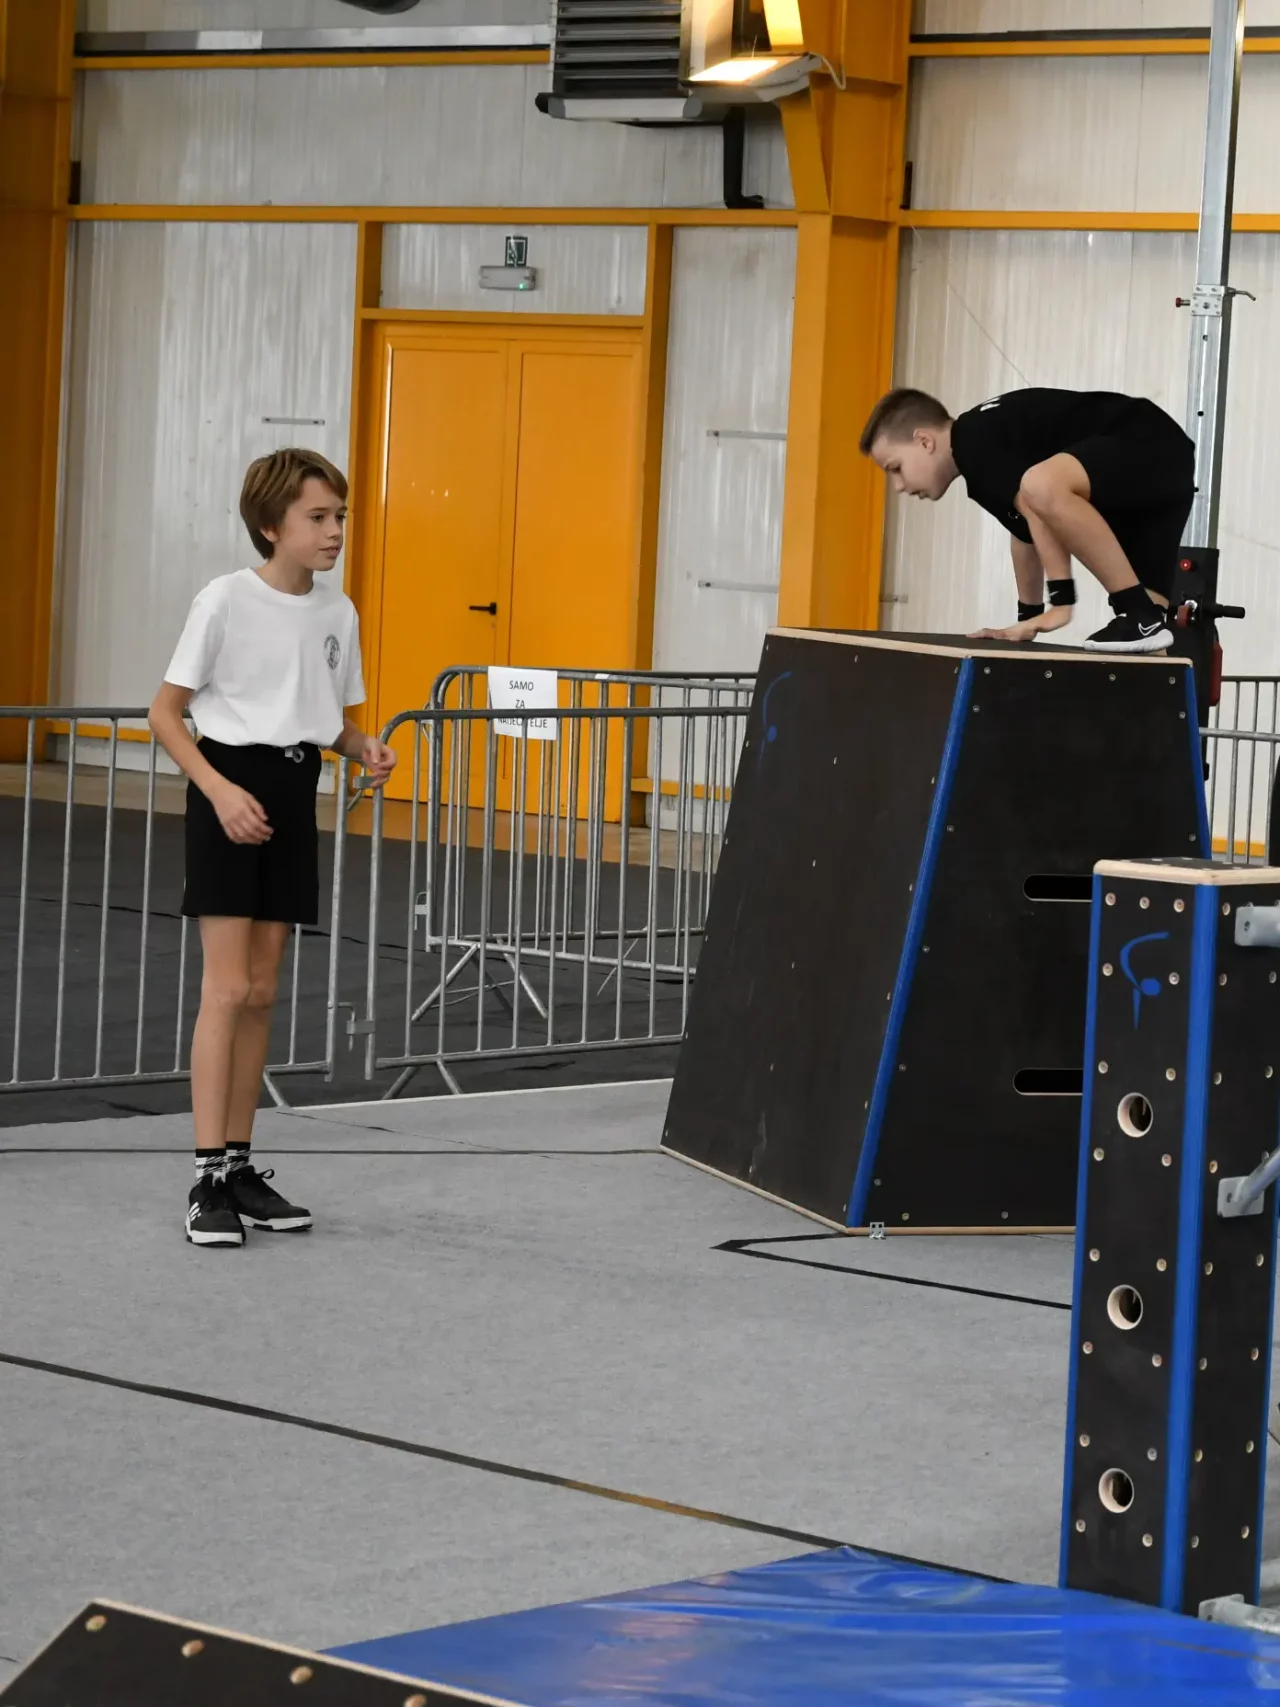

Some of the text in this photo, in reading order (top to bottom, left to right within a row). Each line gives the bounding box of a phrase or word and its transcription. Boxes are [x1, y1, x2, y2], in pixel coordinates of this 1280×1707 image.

[509, 680, 534, 691] SAMO
[515, 699, 525, 709] ZA
[498, 717, 548, 728] NATJECELJE
